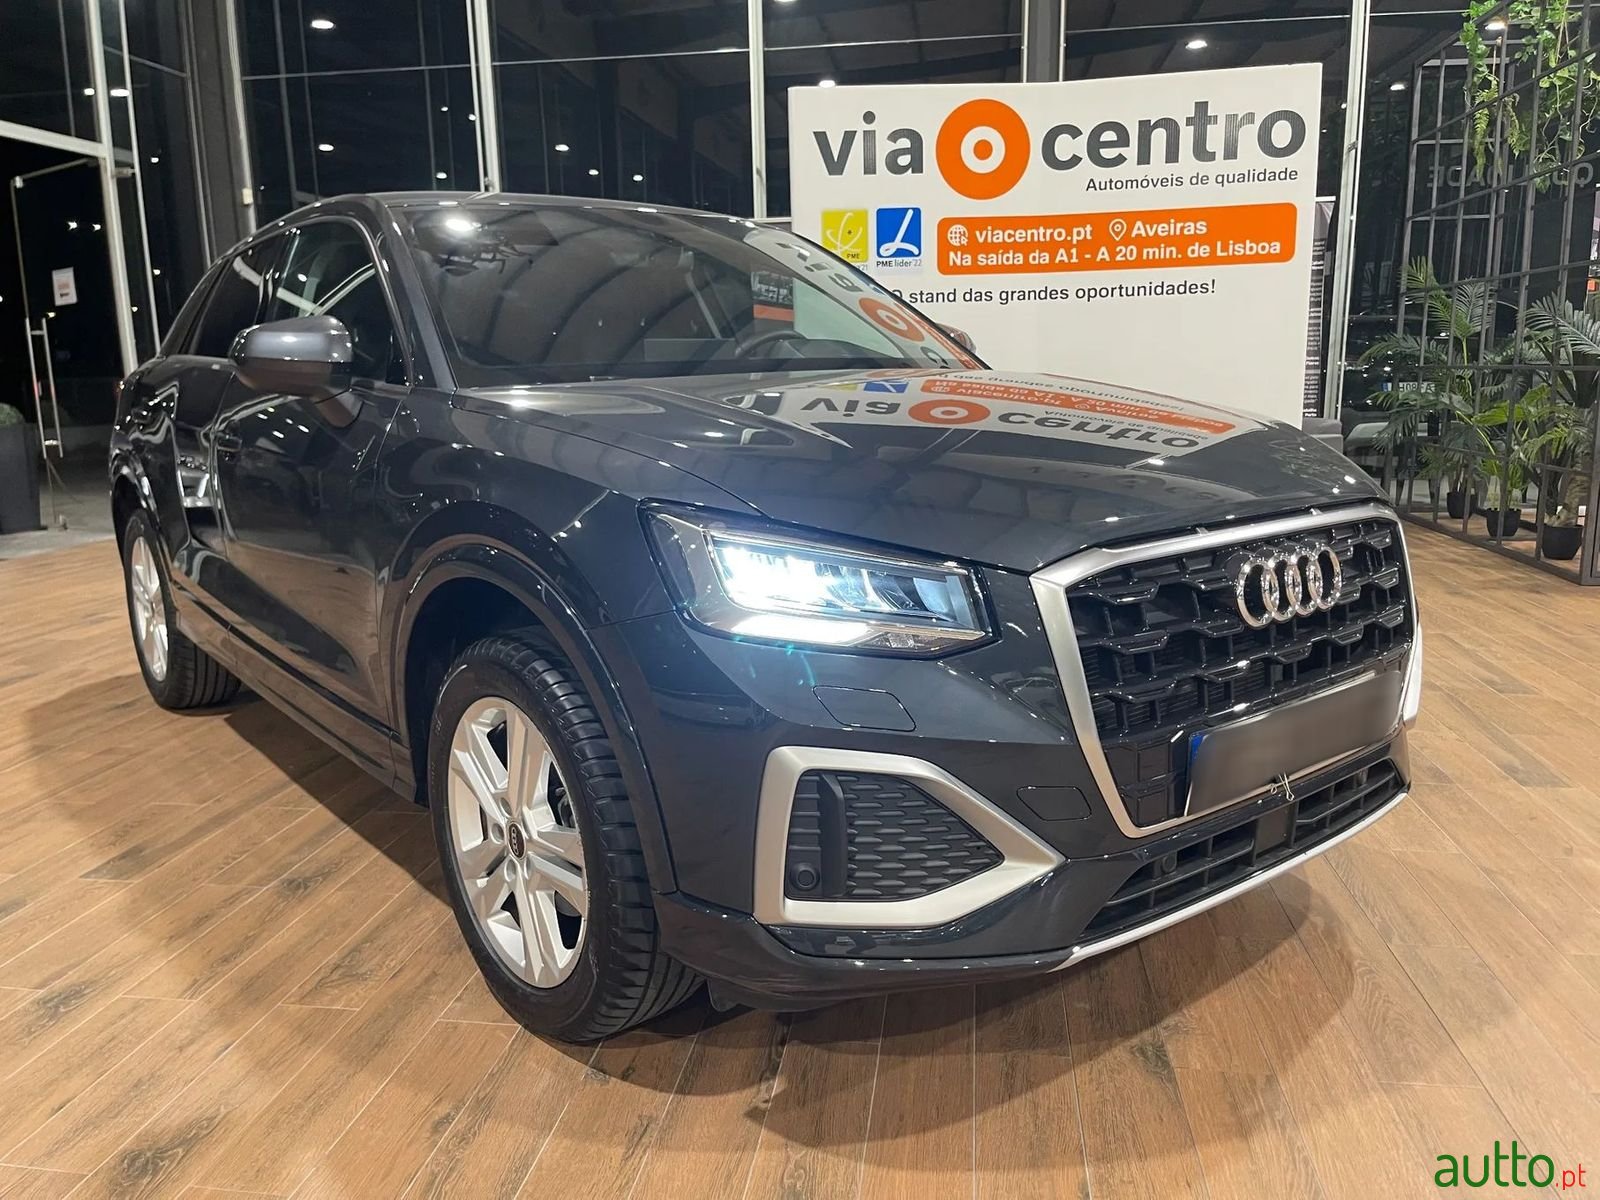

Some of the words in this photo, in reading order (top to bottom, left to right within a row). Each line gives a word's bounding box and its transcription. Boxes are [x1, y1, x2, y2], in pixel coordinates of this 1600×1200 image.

[813, 110, 924, 176] via
[1041, 101, 1307, 171] centro
[1085, 173, 1184, 192] Automóveis
[1189, 172, 1210, 186] de
[1215, 167, 1299, 187] qualidade
[975, 224, 1093, 244] viacentro.pt
[1131, 219, 1208, 238] Aveiras
[949, 251, 972, 266] Na
[977, 249, 1024, 266] saída
[1029, 249, 1050, 264] da
[1055, 247, 1079, 263] A1
[1096, 246, 1110, 262] A
[1115, 245, 1137, 261] 20
[1142, 244, 1183, 260] min.
[1187, 242, 1210, 258] de
[1216, 240, 1281, 256] Lisboa
[909, 288, 956, 303] stand
[963, 288, 993, 303] das
[1000, 286, 1069, 305] grandes
[1075, 279, 1216, 302] oportunidades!
